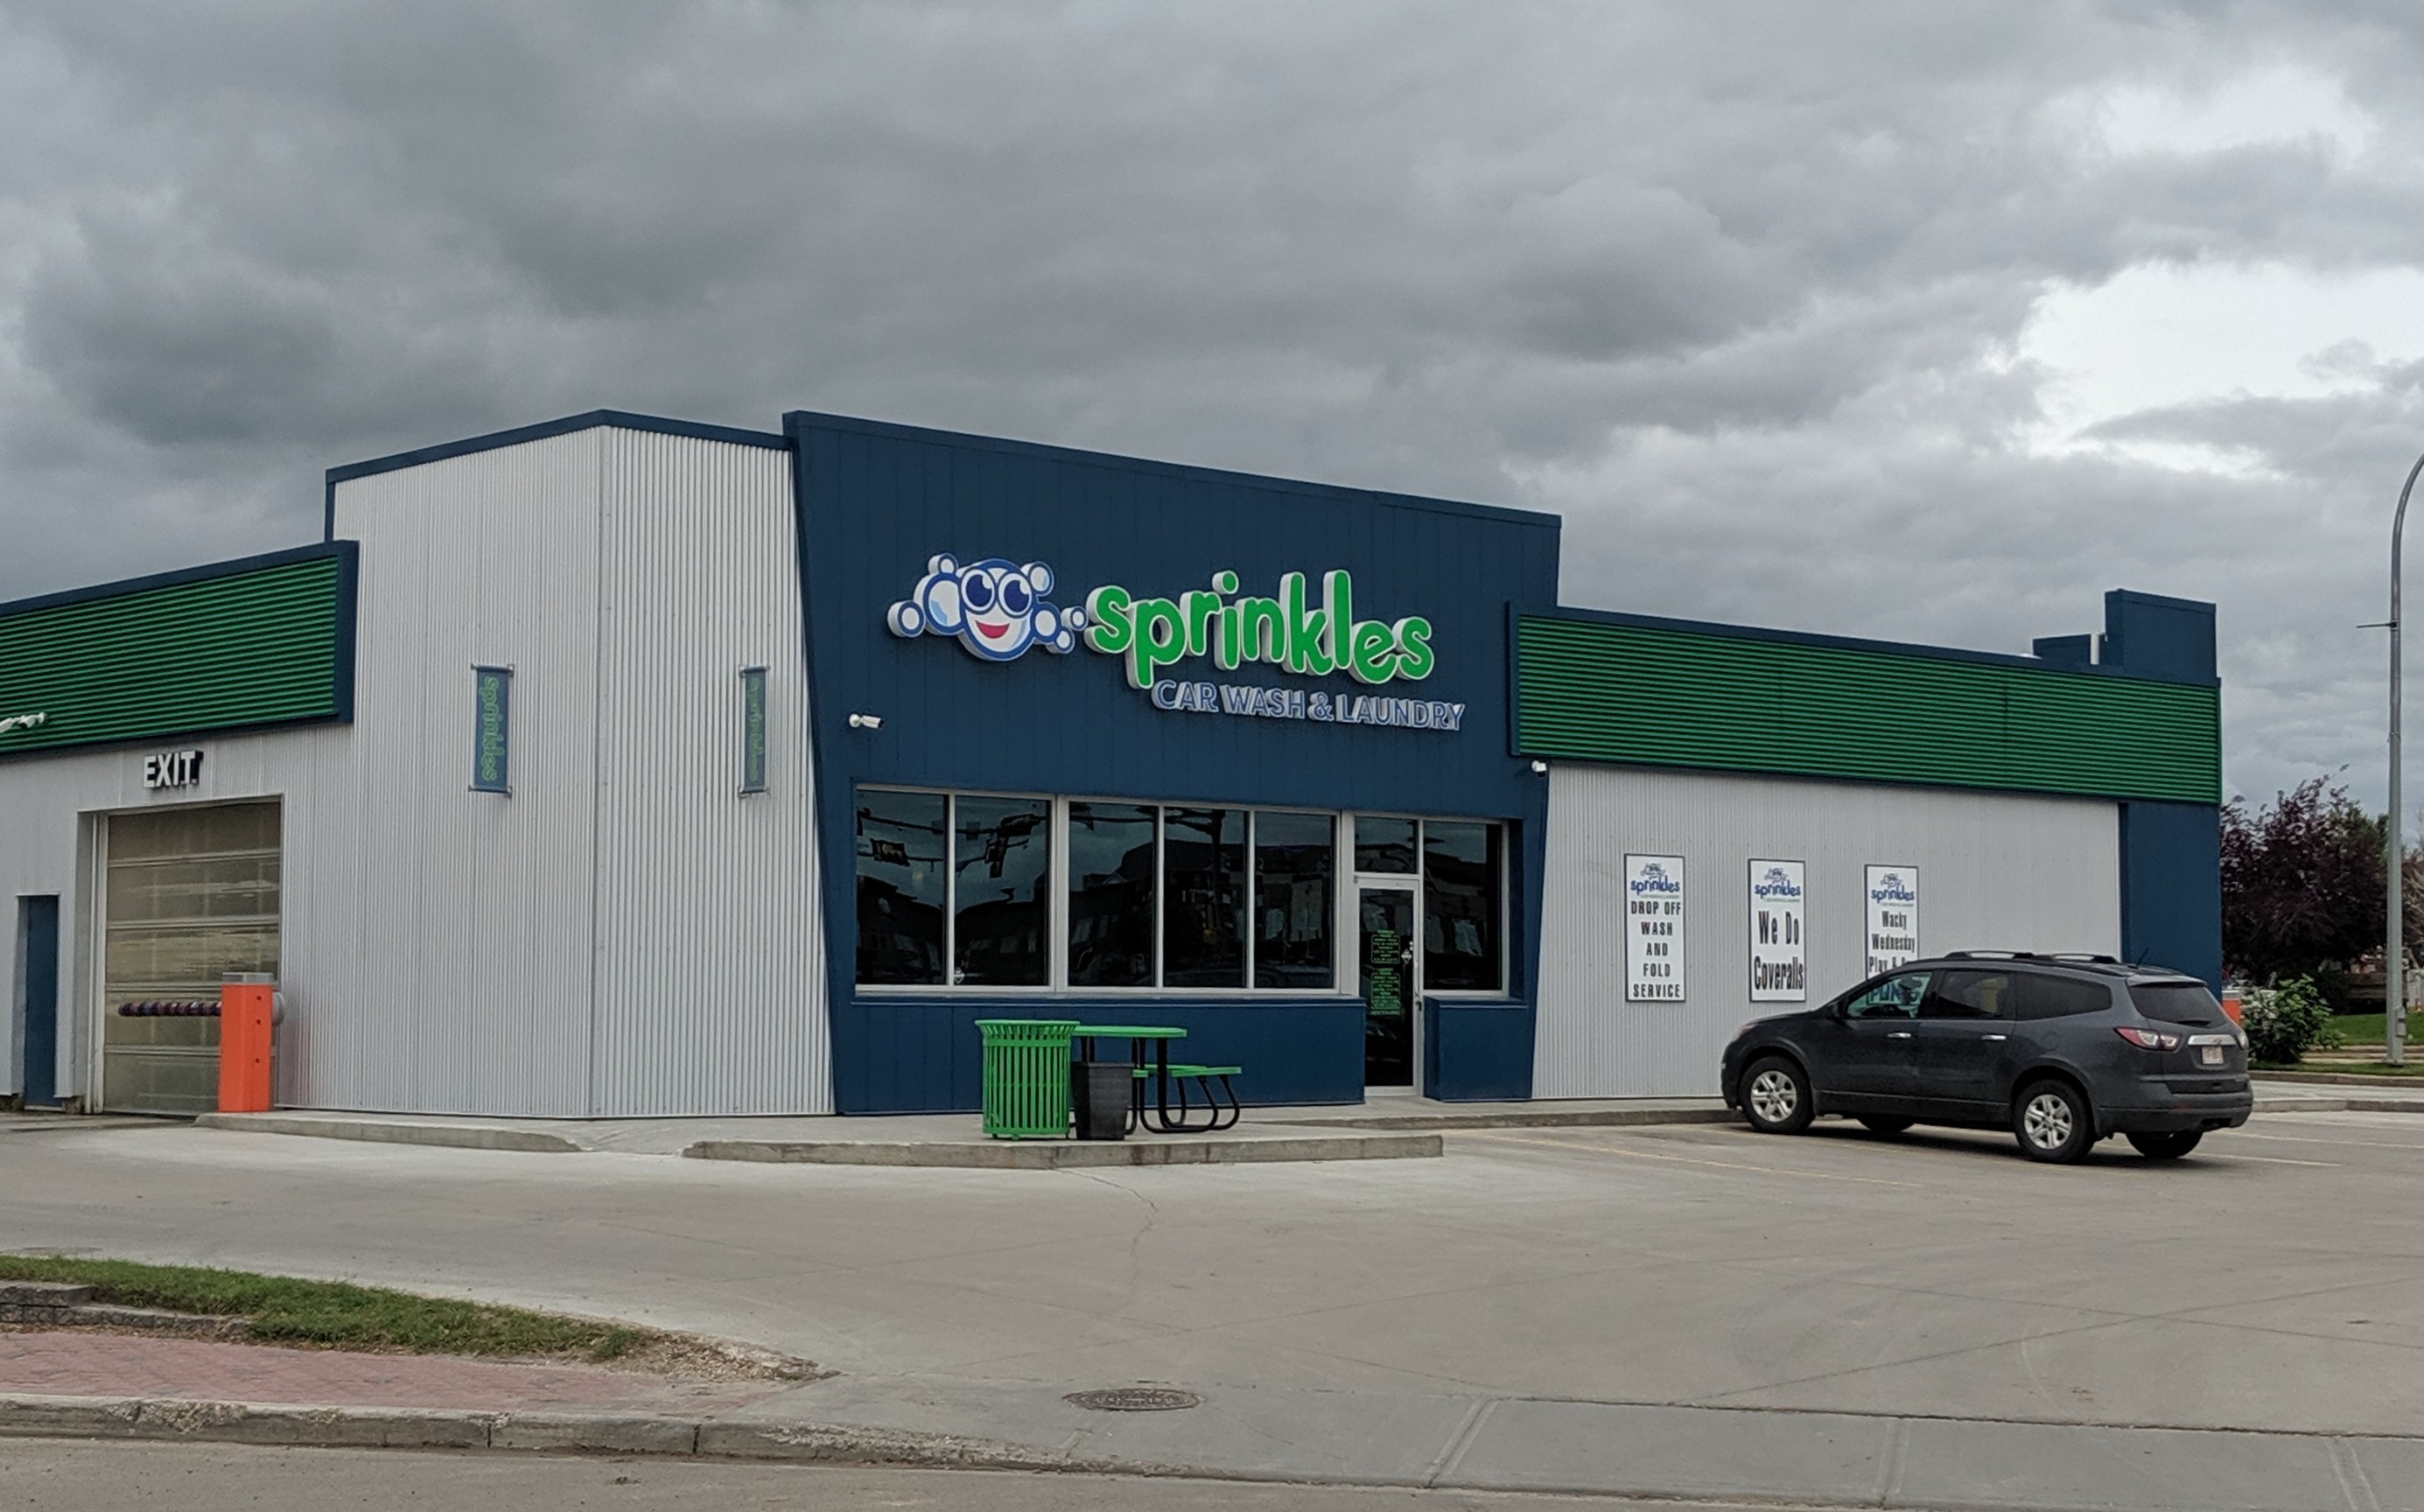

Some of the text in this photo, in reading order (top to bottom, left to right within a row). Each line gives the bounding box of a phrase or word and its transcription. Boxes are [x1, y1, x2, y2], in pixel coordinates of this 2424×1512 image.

[1085, 569, 1435, 690] sprinkles
[1152, 680, 1466, 732] CAR WASH & LAUNDRY
[479, 676, 506, 781] sprinkles
[143, 750, 198, 788] EXIT
[1630, 900, 1681, 916] DROP OFF
[1641, 921, 1672, 936] WASH
[1757, 910, 1799, 946] We Do
[1881, 911, 1907, 931] Wacky
[1646, 942, 1668, 956] AND
[1871, 934, 1915, 954] Wednesday
[1643, 962, 1671, 977] FOLD
[1754, 955, 1804, 990] Coveralls
[1633, 984, 1680, 998] SERVICE
